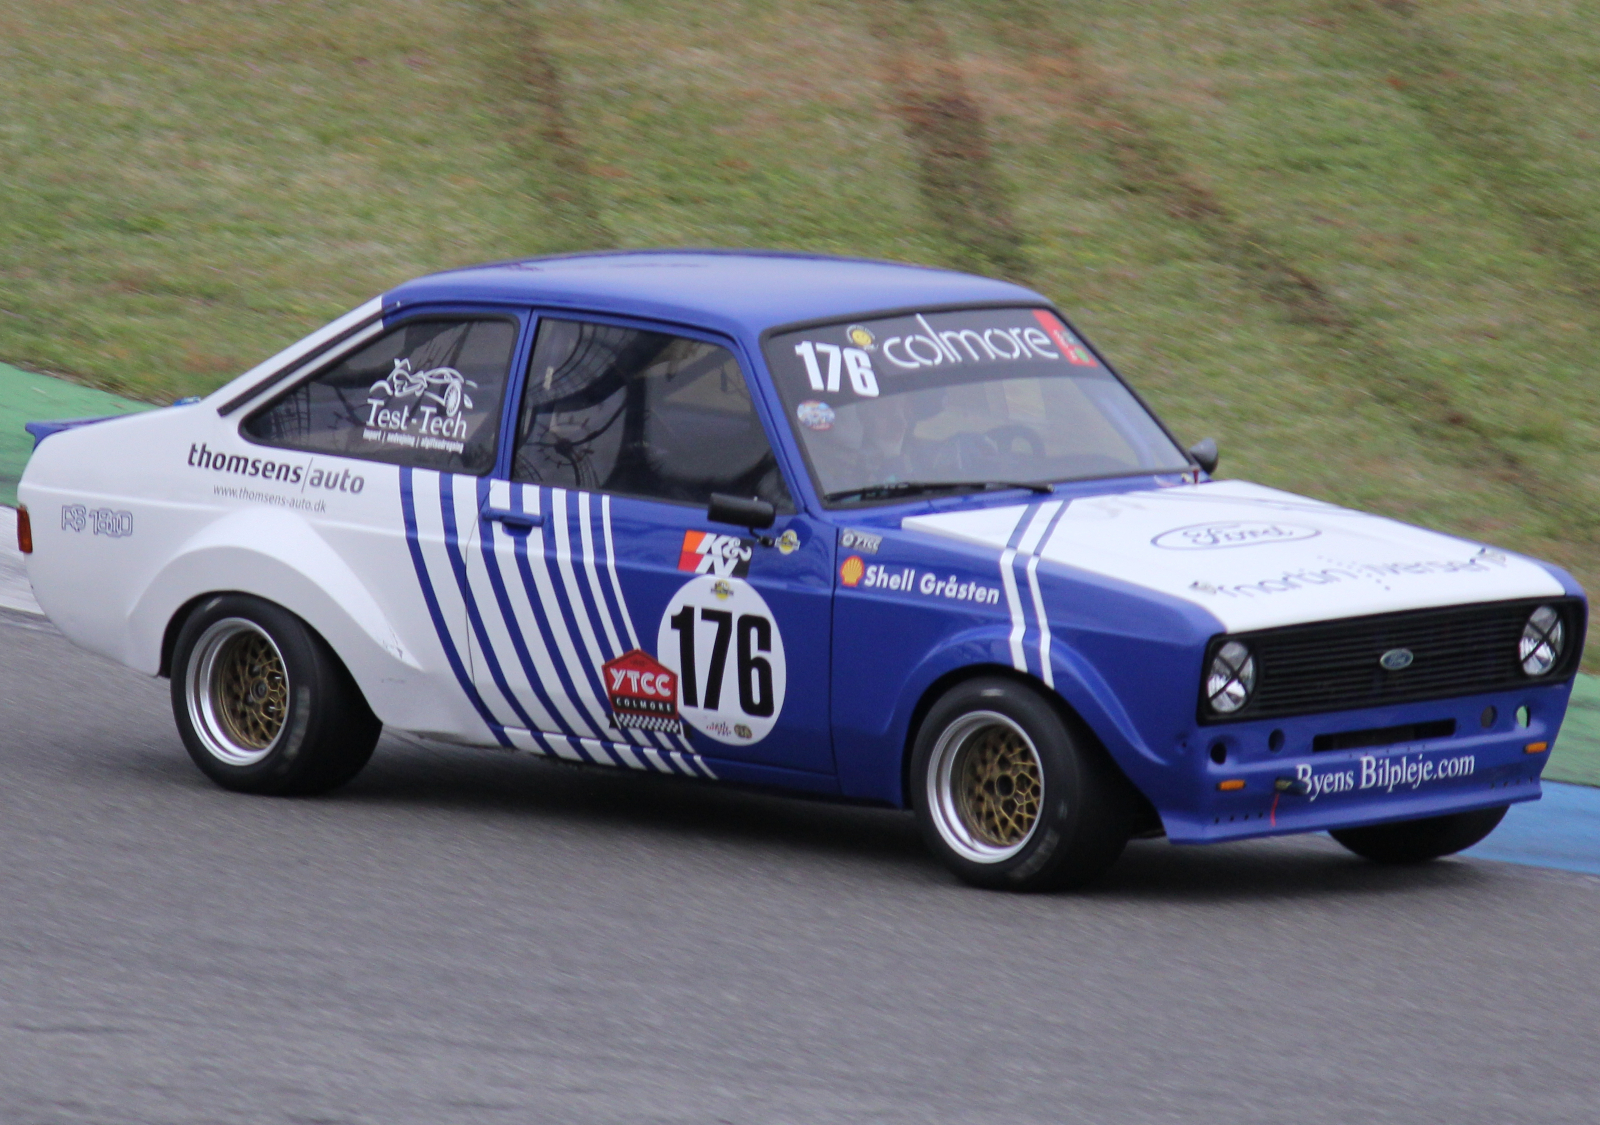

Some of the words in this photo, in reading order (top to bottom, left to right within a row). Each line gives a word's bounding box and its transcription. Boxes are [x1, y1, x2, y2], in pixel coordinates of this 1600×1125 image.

[883, 313, 1059, 369] colmore
[794, 340, 880, 397] 176
[213, 484, 327, 513] www.thomsens-auto.dk
[864, 564, 916, 592] Shell
[920, 572, 1000, 605] Gråsten
[609, 667, 671, 697] YTCC
[670, 605, 775, 718] 176
[616, 697, 672, 712] COLMORE
[1296, 763, 1355, 802] Byens
[1359, 753, 1476, 794] Bilpleje.com
